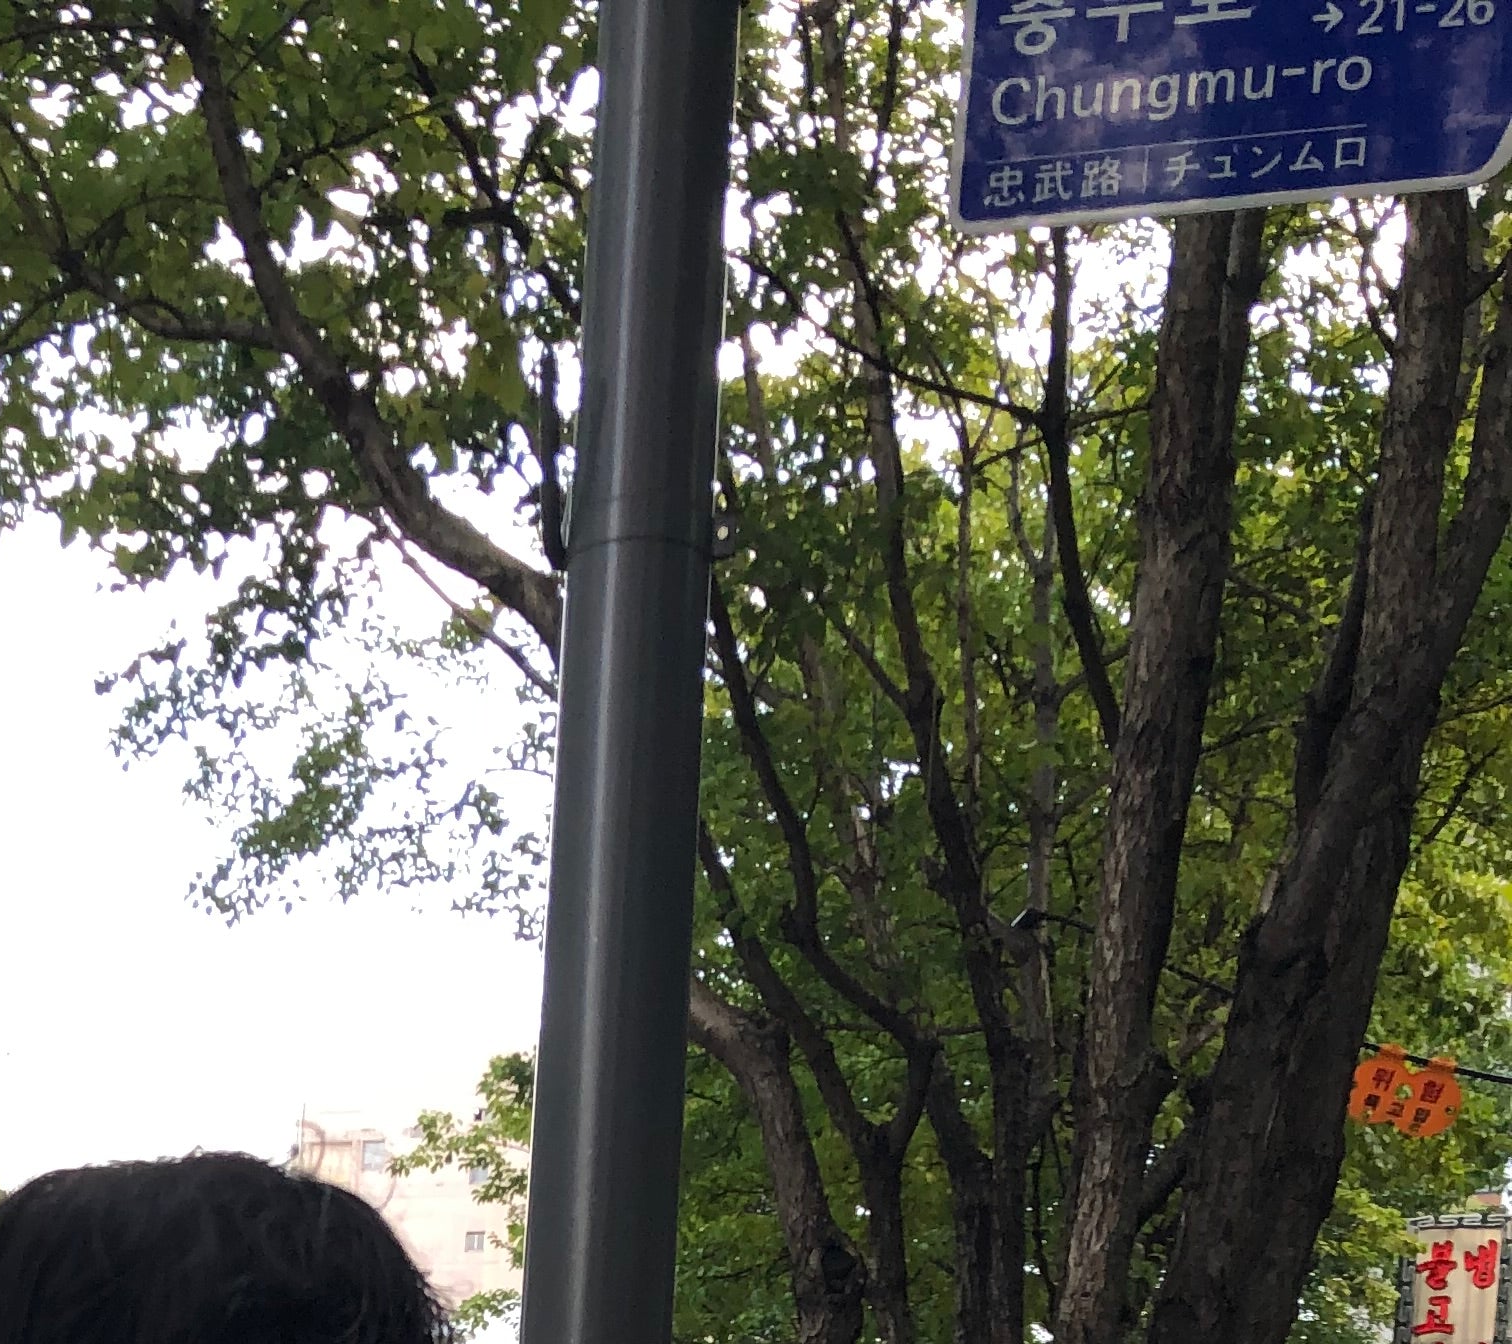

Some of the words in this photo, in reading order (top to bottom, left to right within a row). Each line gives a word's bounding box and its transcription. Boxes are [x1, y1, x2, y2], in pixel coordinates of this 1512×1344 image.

[1357, 0, 1496, 35] 21-26
[991, 55, 1373, 125] Chungmu-ro
[984, 157, 1123, 208] 忠武路
[1164, 137, 1368, 187] チュンムロ
